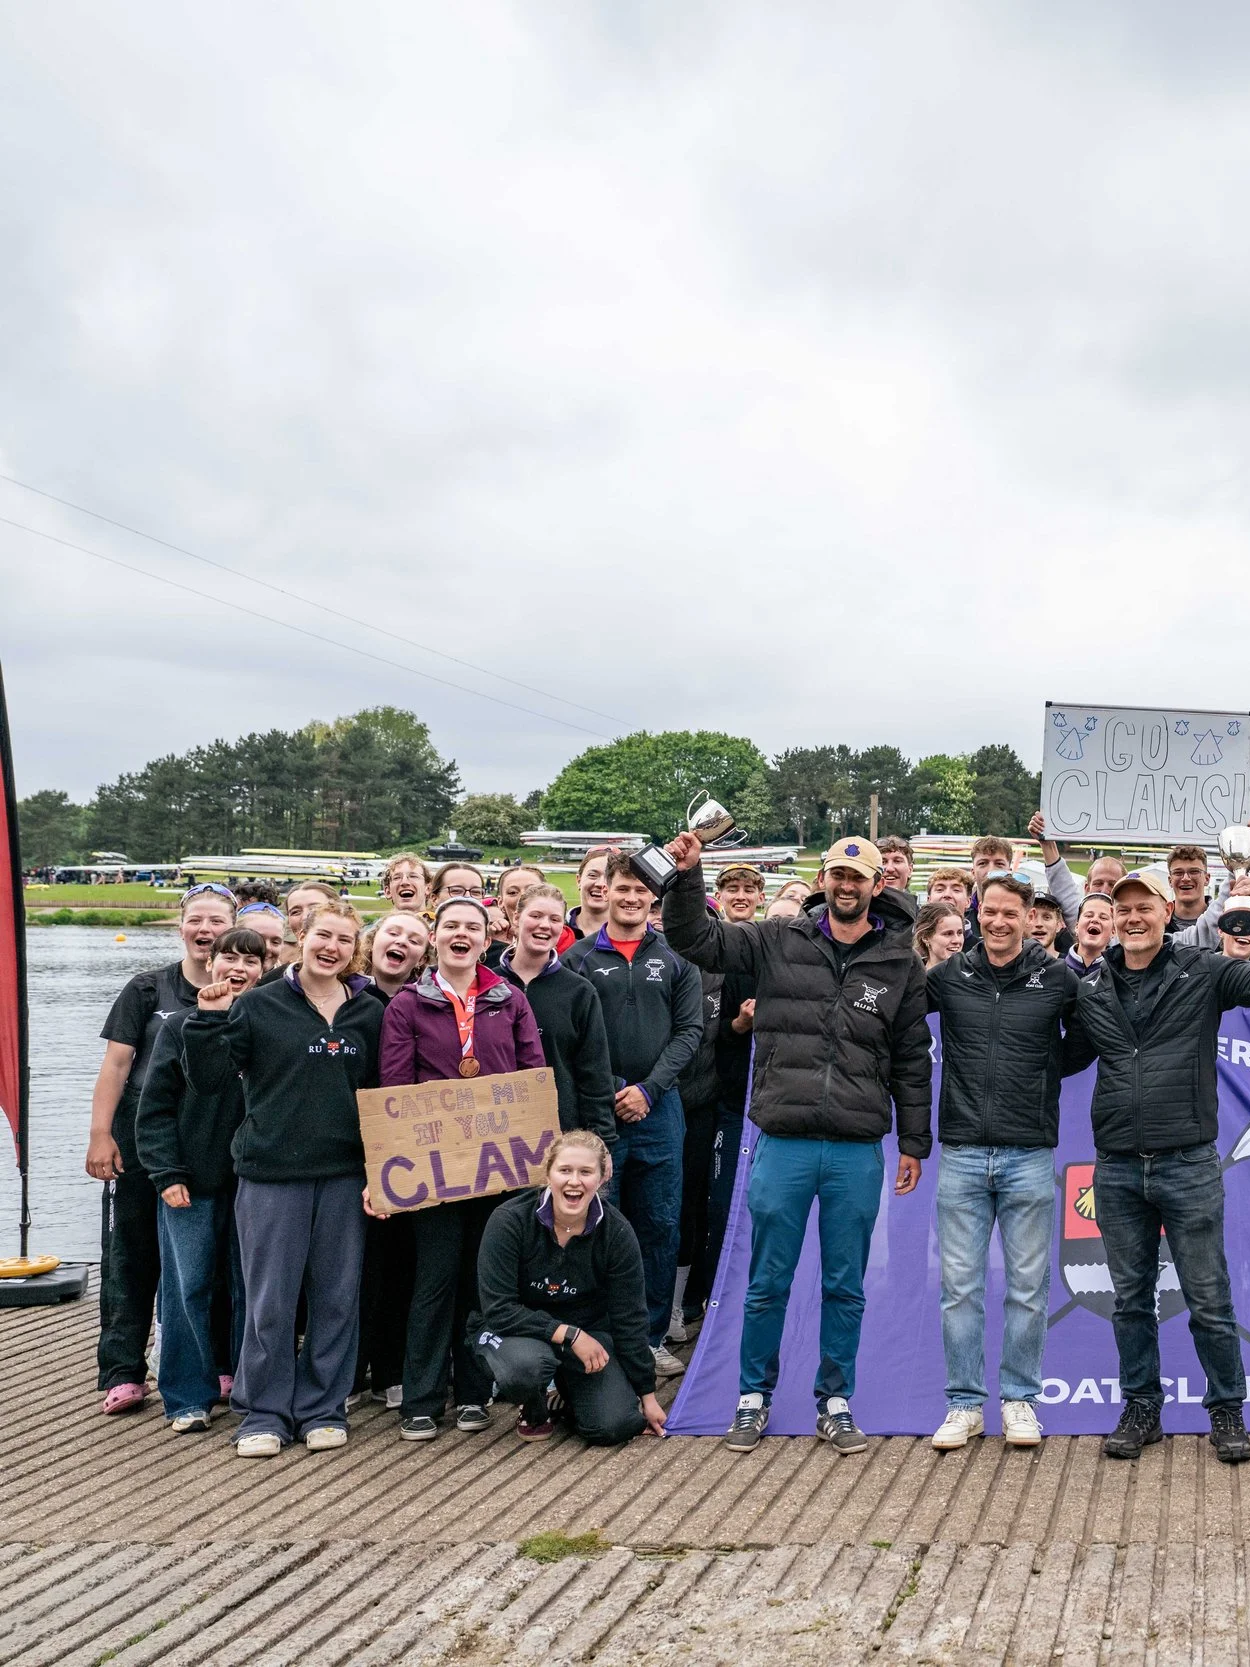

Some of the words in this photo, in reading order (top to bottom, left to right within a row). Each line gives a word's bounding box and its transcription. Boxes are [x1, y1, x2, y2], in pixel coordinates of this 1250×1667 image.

[1104, 715, 1168, 772] GO
[466, 996, 475, 1013] BUCS
[853, 1001, 878, 1014] RUBC
[344, 1046, 356, 1054] BC
[385, 1088, 475, 1118] CATCH
[491, 1081, 529, 1105] ME
[413, 1120, 442, 1146] IF
[454, 1110, 509, 1139] YOU
[530, 1281, 544, 1289] RU
[563, 1286, 577, 1294] BC
[1036, 1378, 1120, 1403] OAT
